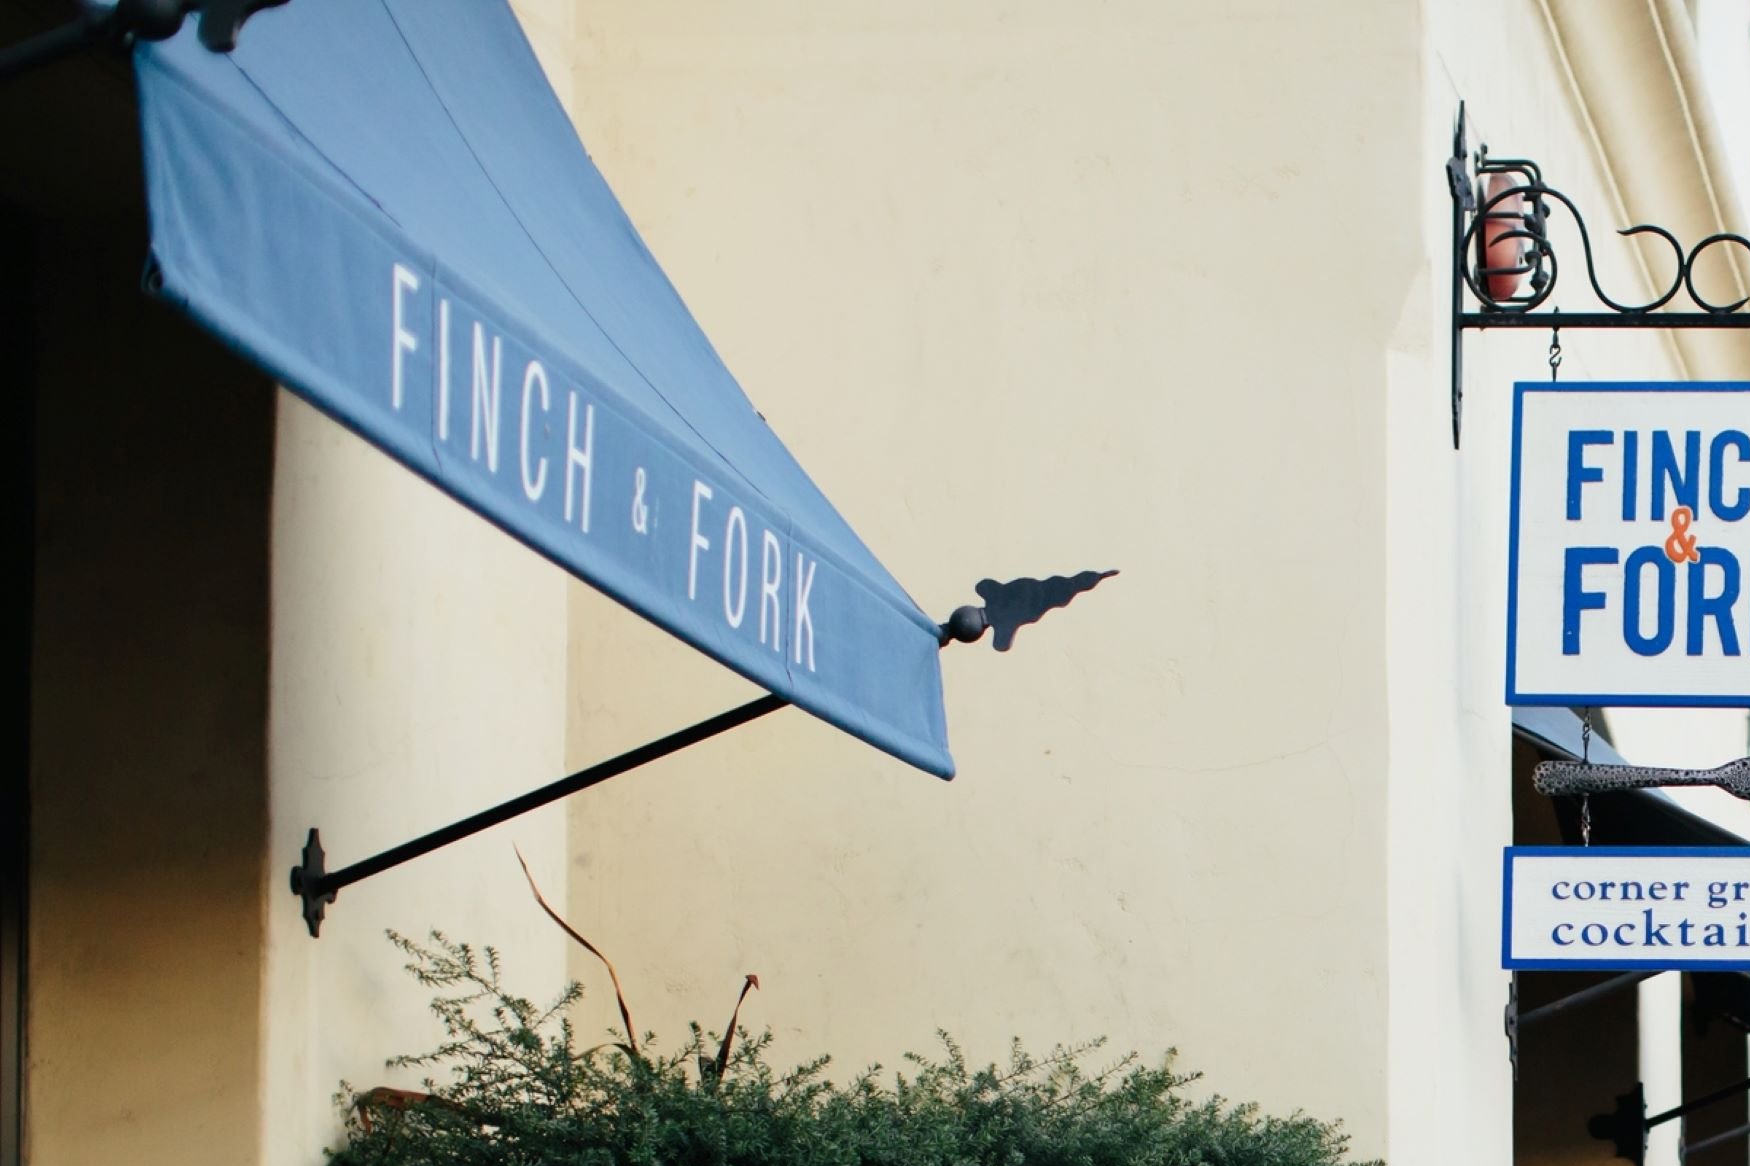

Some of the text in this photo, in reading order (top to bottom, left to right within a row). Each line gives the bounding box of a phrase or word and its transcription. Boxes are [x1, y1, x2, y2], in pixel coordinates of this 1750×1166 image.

[391, 262, 818, 673] FINCH & FORK
[1664, 505, 1699, 565] &
[1551, 878, 1690, 902] corner
